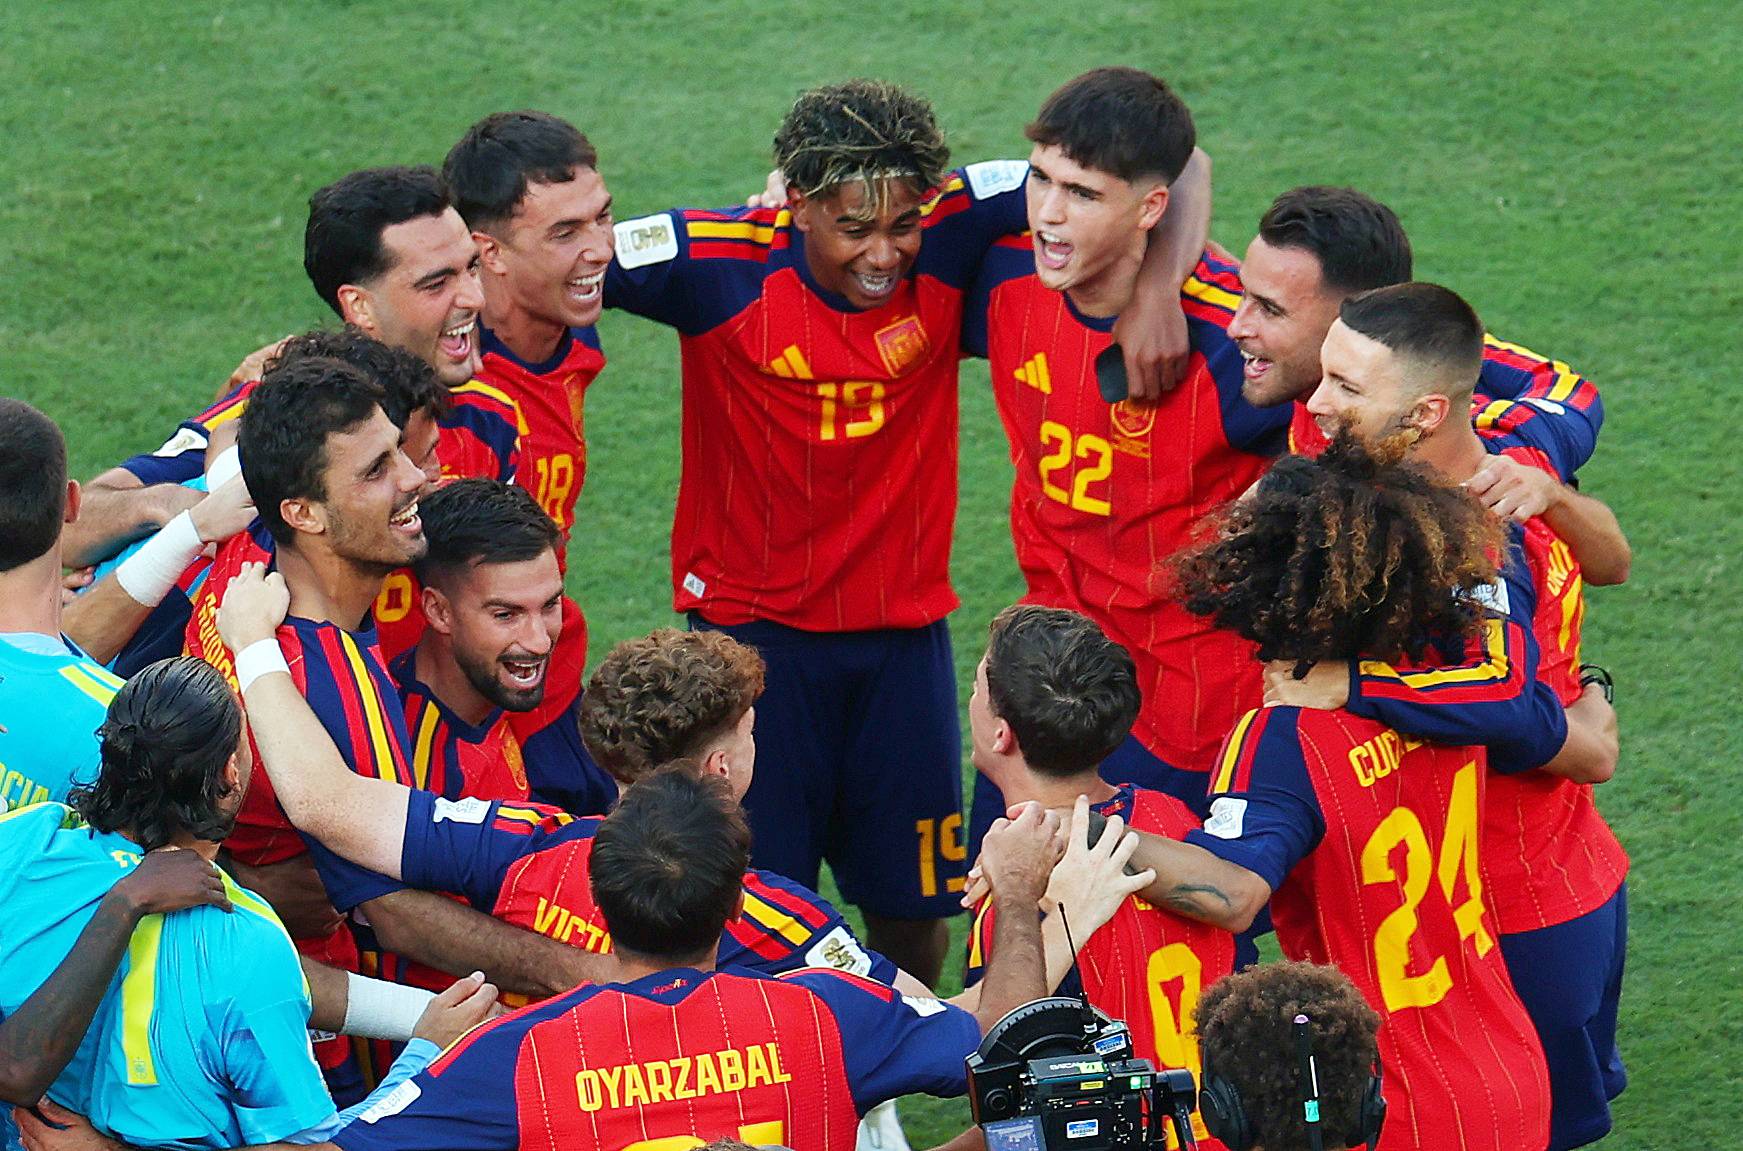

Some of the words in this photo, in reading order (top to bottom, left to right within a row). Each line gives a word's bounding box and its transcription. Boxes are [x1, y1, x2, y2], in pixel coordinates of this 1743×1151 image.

[817, 382, 885, 441] 19
[537, 453, 573, 527] 18
[1039, 421, 1113, 516] 22
[1361, 760, 1495, 1013] 24
[576, 1043, 792, 1111] OYARZABAL
